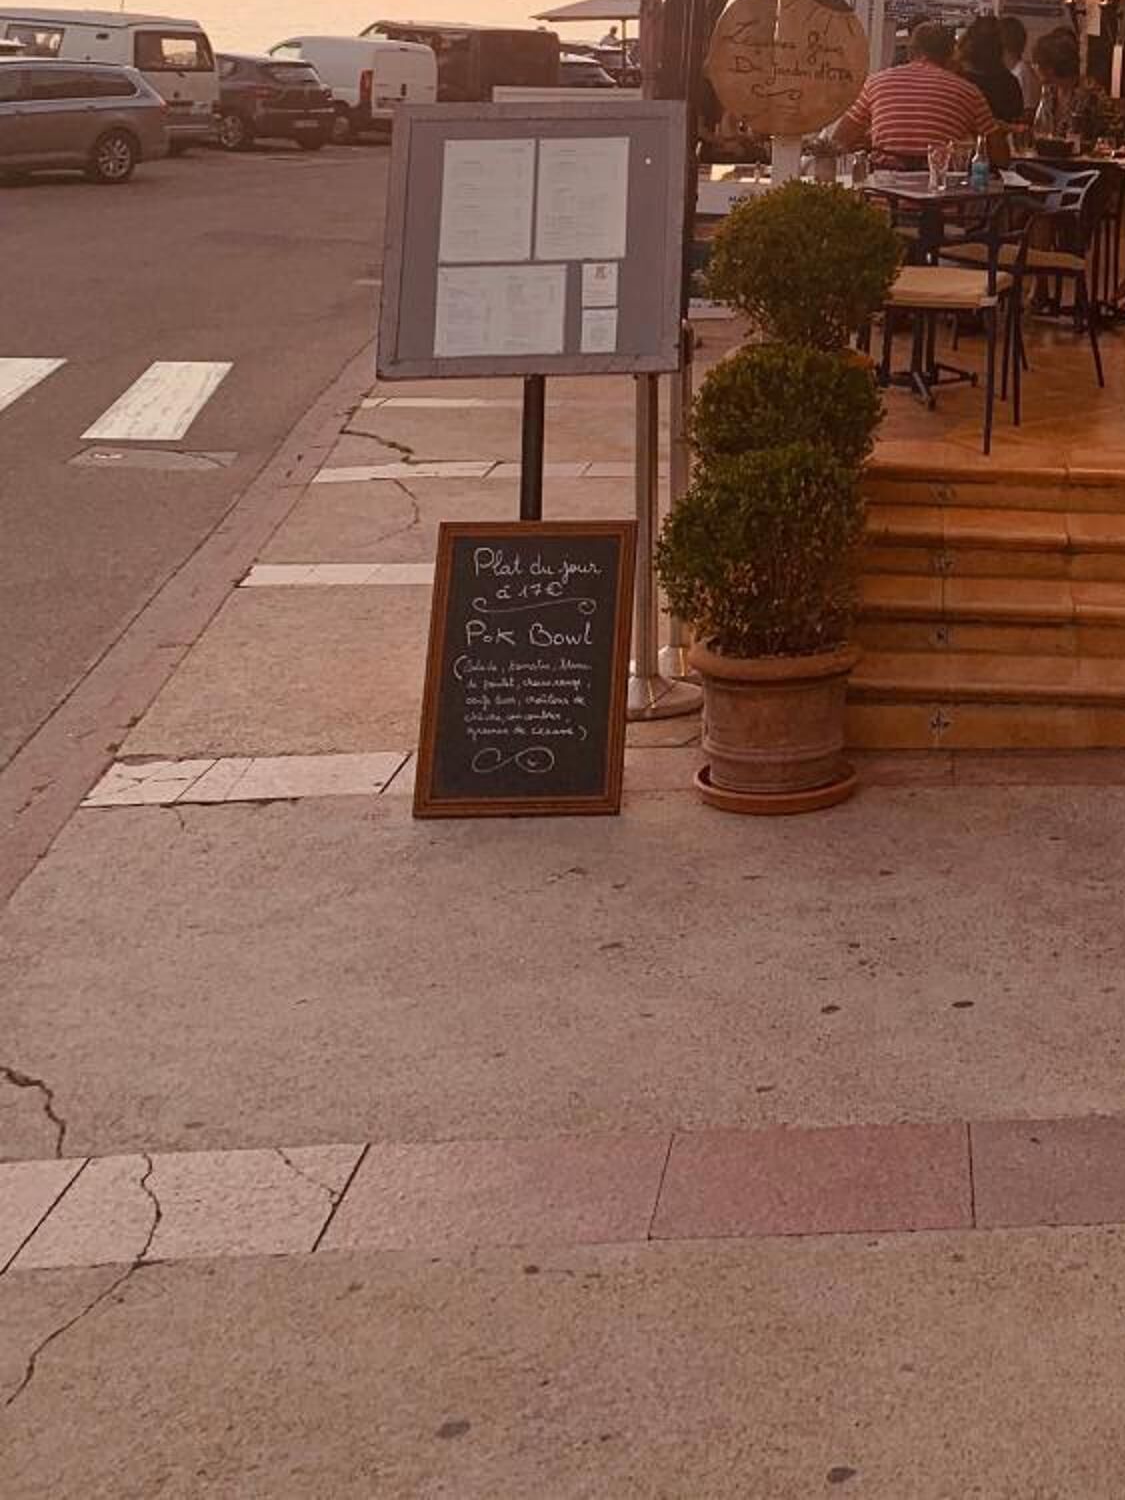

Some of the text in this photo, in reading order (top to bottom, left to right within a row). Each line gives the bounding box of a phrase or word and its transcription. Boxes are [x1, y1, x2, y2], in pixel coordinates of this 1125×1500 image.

[473, 547, 602, 585] Plat du jour
[516, 580, 565, 599] 17€
[529, 621, 594, 647] Bowl
